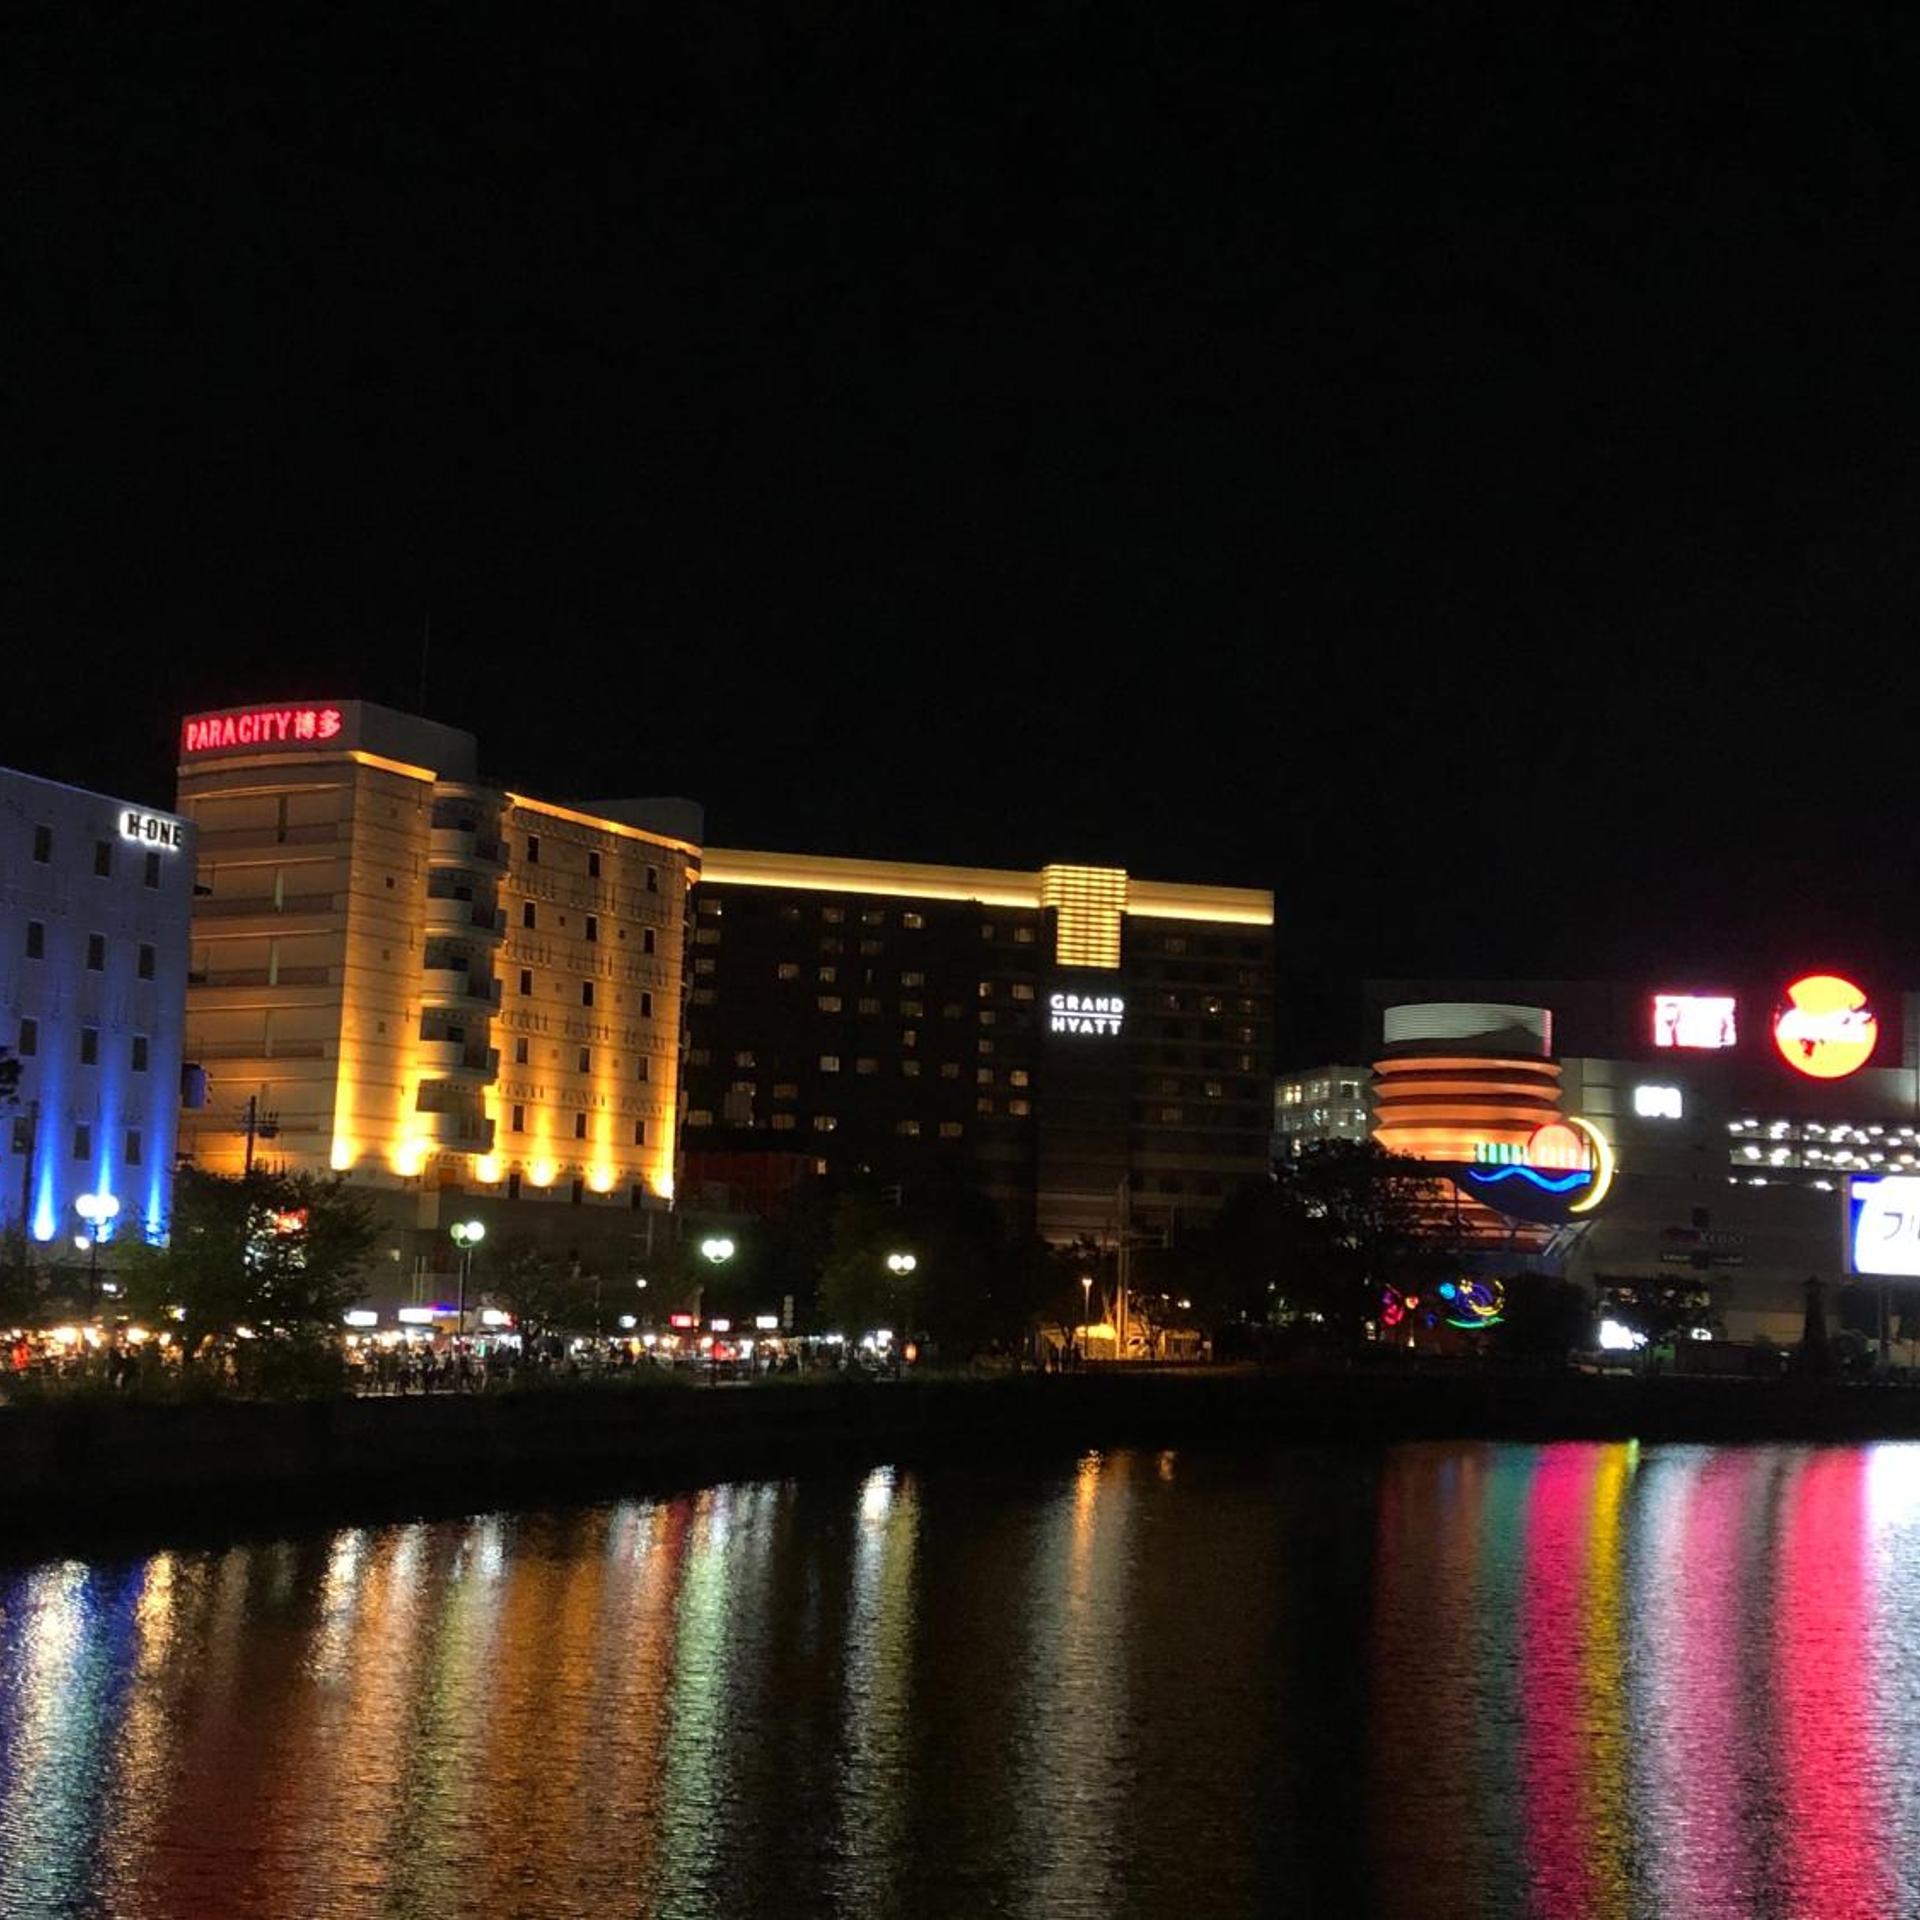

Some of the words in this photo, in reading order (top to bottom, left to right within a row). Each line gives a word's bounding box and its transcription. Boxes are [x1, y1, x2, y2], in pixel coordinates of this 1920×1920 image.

[186, 711, 291, 751] PARACITY
[126, 812, 184, 848] H-ONE
[1050, 994, 1124, 1013] GRAND
[1051, 1016, 1121, 1035] HYATT
